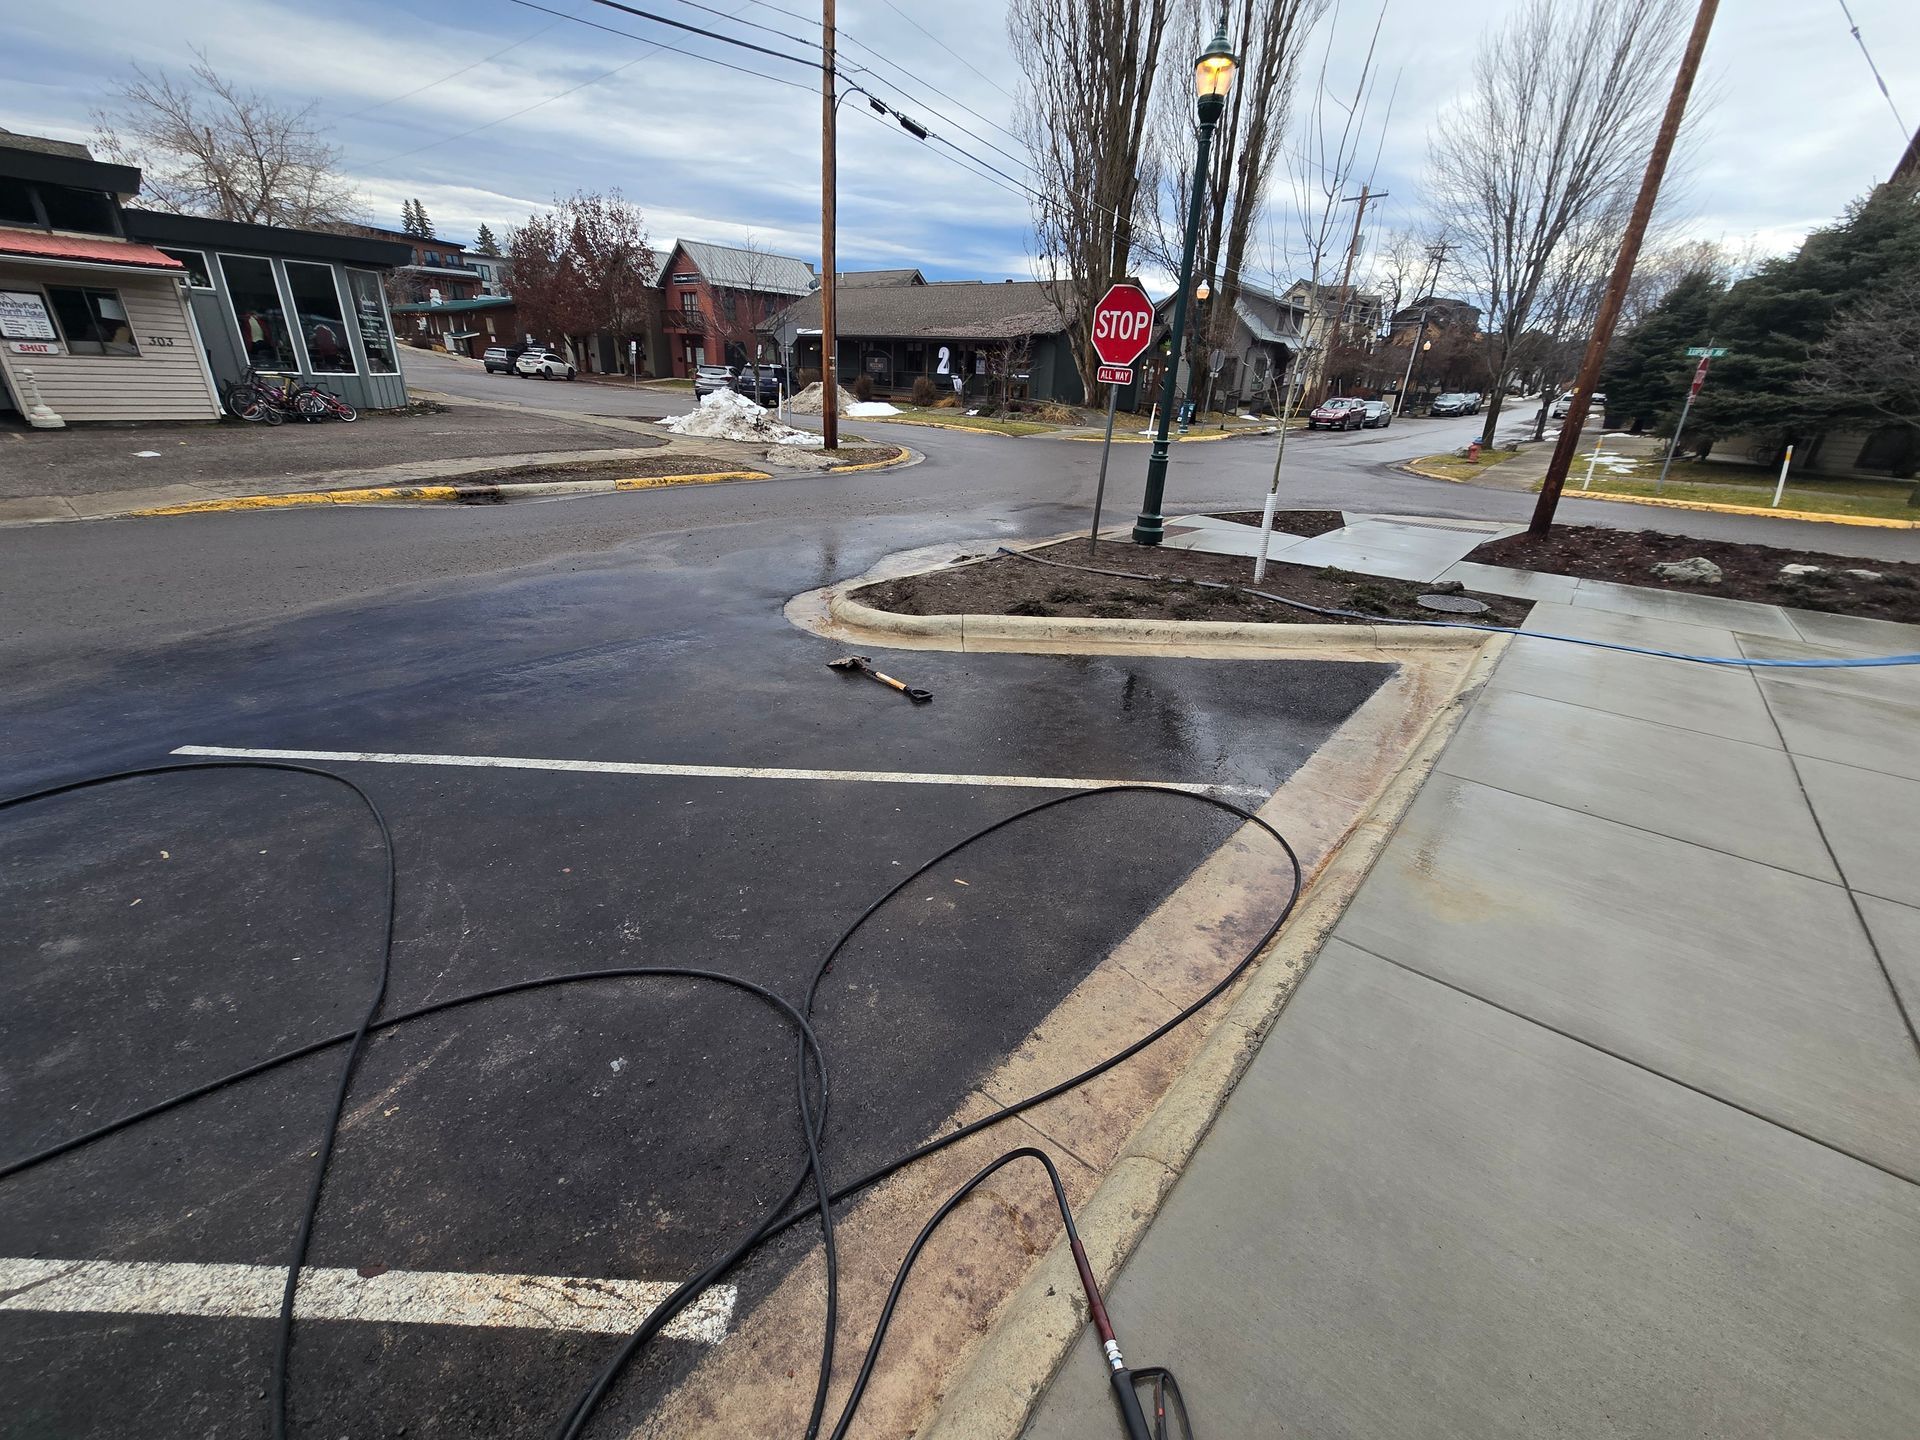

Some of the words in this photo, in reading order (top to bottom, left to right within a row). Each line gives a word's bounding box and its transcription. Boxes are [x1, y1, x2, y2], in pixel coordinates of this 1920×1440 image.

[1096, 310, 1149, 340] STOP
[148, 336, 174, 347] 303
[19, 343, 48, 353] SHUT
[1100, 369, 1113, 380] ALL
[1115, 370, 1130, 381] WAY
